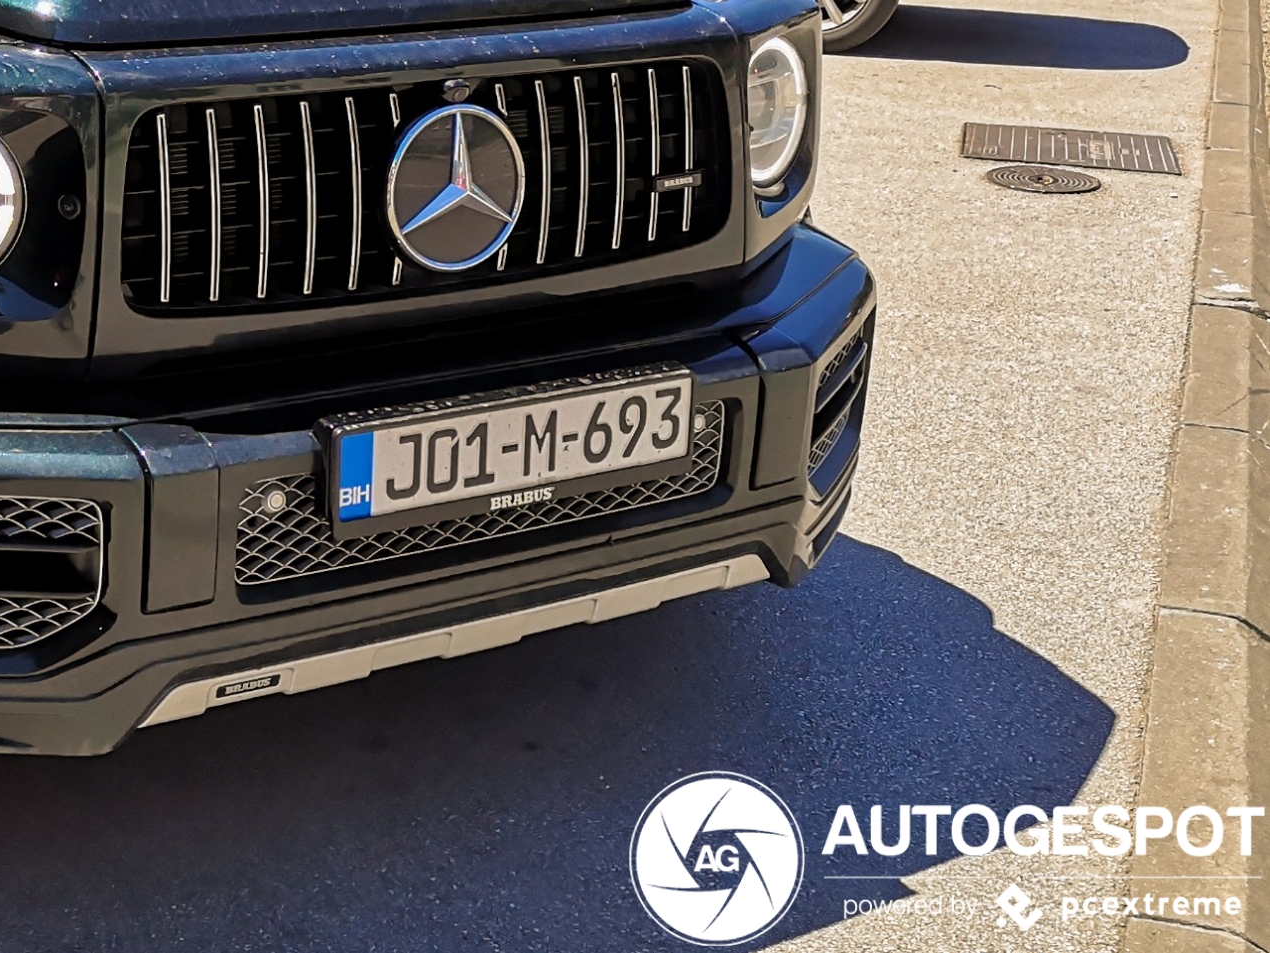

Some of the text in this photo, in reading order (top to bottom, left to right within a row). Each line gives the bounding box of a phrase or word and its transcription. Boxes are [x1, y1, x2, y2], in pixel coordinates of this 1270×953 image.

[385, 386, 682, 501] J01-M-693
[339, 483, 371, 508] BIH
[490, 488, 553, 511] BRABUS
[225, 677, 272, 695] BRABUS
